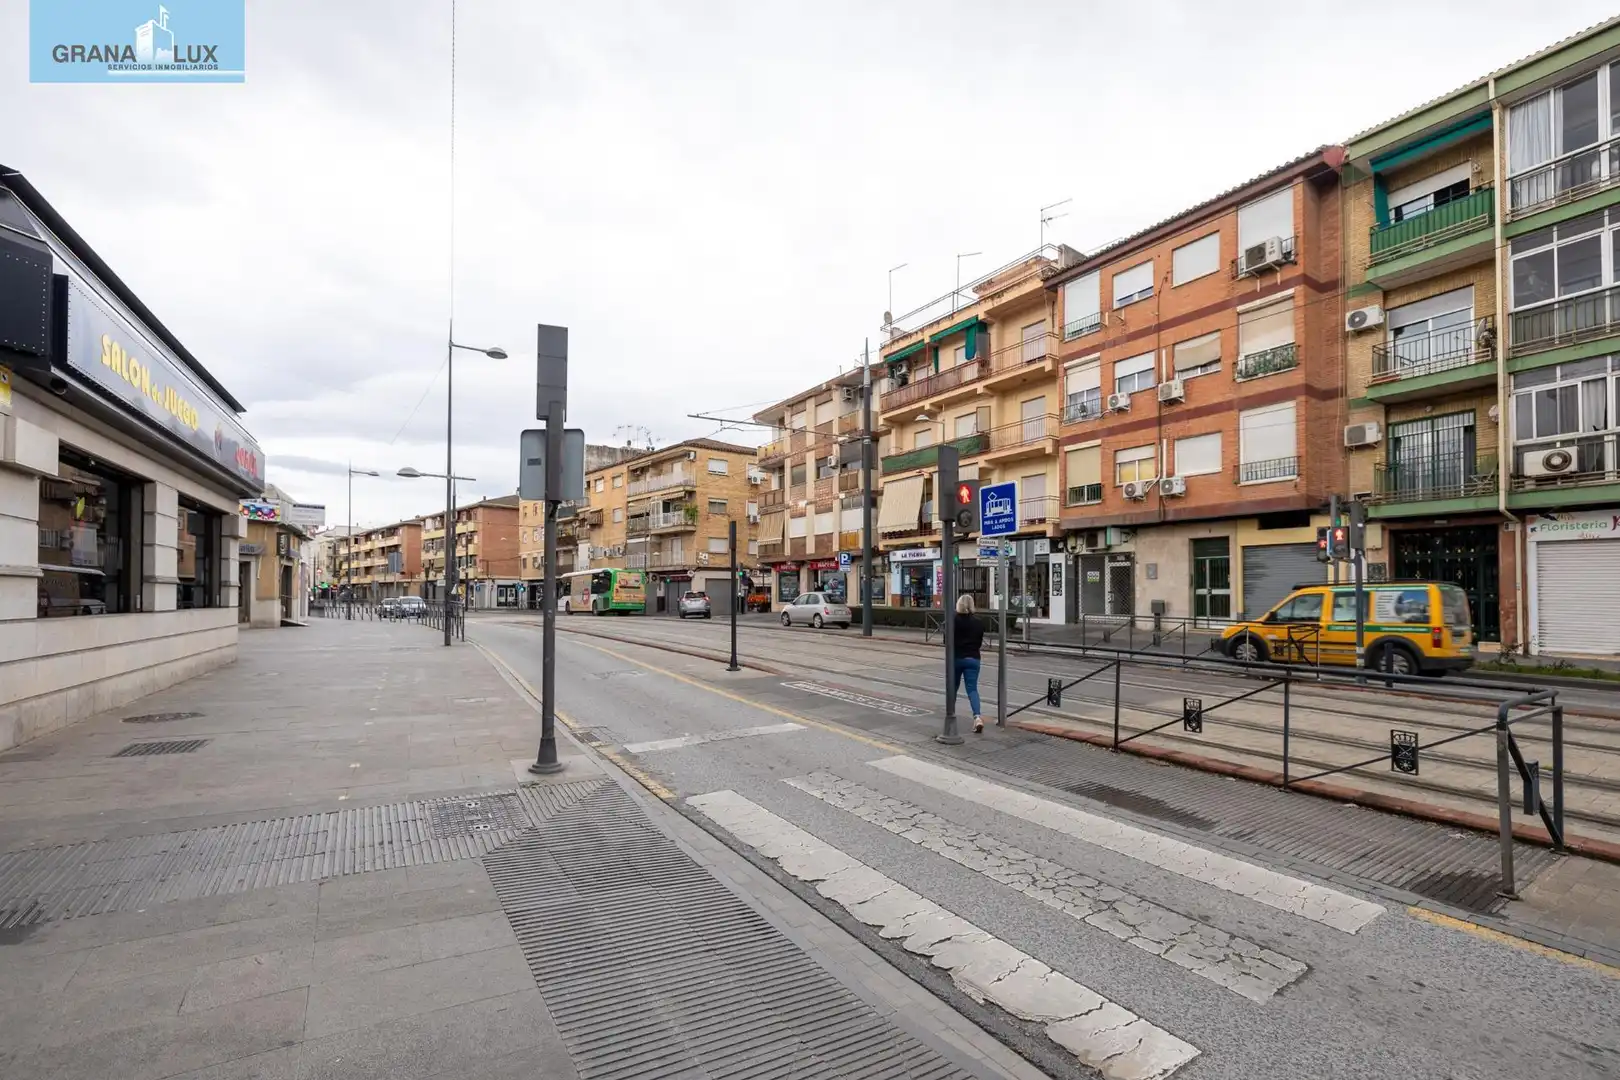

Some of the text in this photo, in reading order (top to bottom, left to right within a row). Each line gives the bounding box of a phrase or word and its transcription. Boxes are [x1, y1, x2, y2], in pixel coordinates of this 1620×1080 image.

[101, 333, 151, 396] SALON
[164, 386, 199, 431] JUEGO
[1540, 520, 1608, 532] Floristeria
[842, 553, 849, 564] P
